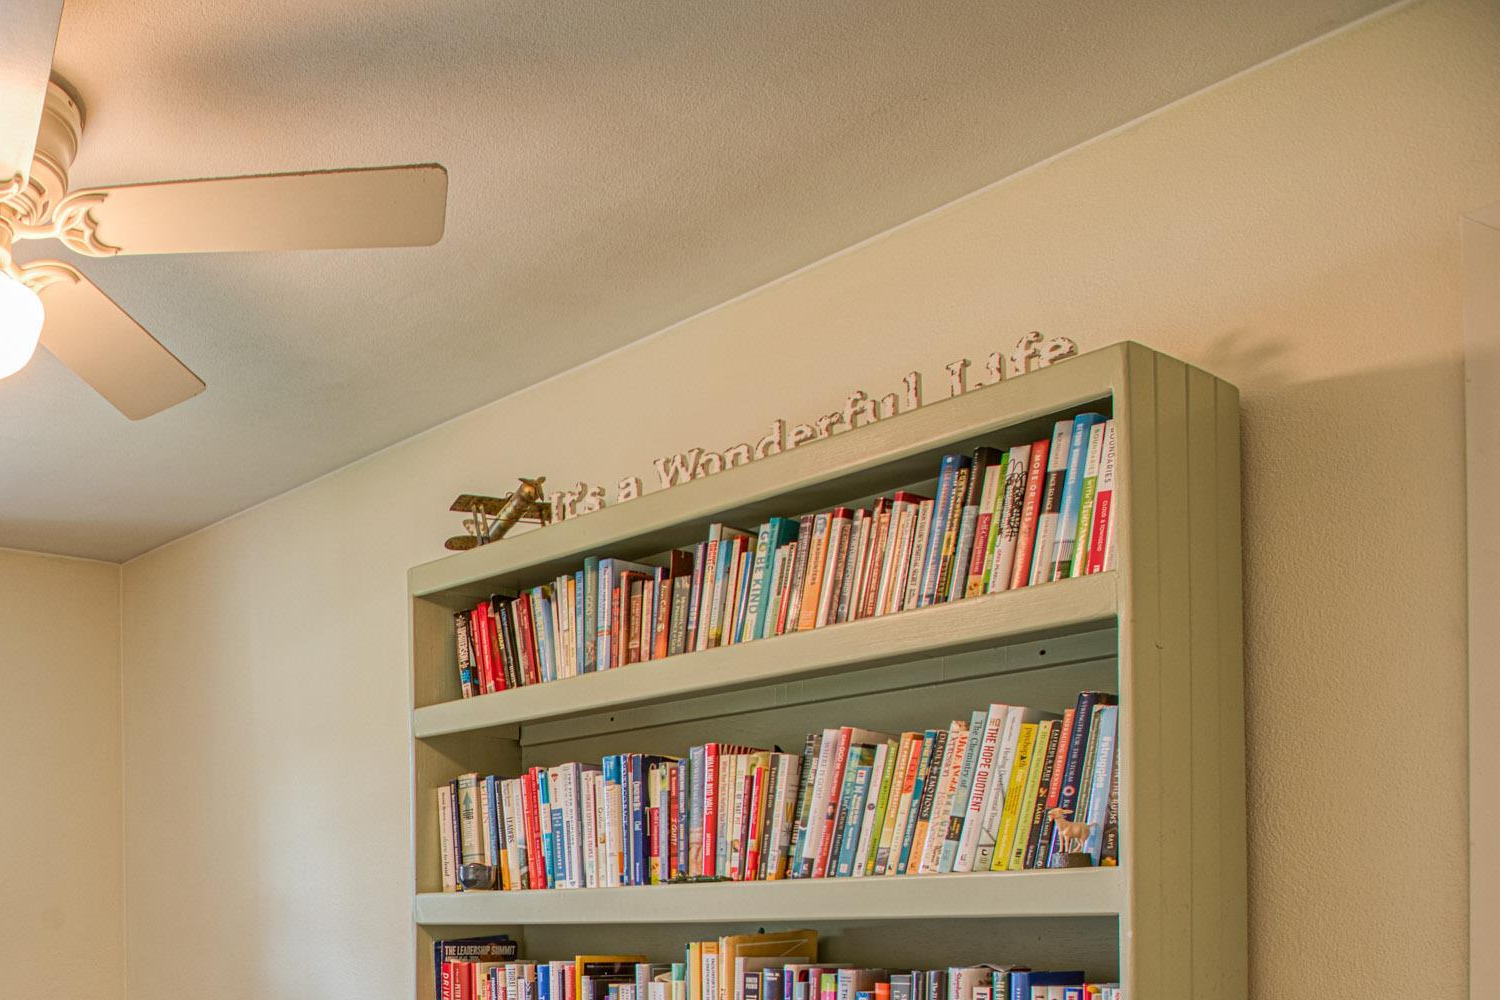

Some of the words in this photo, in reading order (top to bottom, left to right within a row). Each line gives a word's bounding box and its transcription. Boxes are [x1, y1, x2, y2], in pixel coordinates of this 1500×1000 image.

[550, 481, 606, 524] It's
[616, 477, 643, 504] a
[653, 371, 922, 490] Wonderful
[1087, 428, 1100, 475] BOUNDARIES
[1031, 454, 1041, 483] MORE
[1029, 485, 1037, 497] OR
[1024, 501, 1034, 522] LESS
[759, 531, 769, 552] GO
[974, 516, 991, 573] Self-Compassion
[754, 557, 766, 577] BE
[810, 538, 822, 585] HEADHUNTERS
[748, 579, 764, 614] KIND
[972, 721, 983, 735] The
[1075, 701, 1087, 732] STRENGTH
[983, 728, 999, 744] THE
[1059, 714, 1071, 752] EMBRACING
[820, 742, 830, 768] WHERE
[838, 747, 846, 762] GOD
[934, 734, 946, 766] DEADLY
[962, 738, 978, 778] Chemistry
[980, 745, 994, 768] HOPE
[1000, 747, 1011, 768] Healing
[1096, 736, 1110, 788] #struggles
[706, 755, 714, 781] WALKING
[1050, 756, 1064, 798] BROKENNESS
[706, 783, 714, 796] INTO
[922, 776, 937, 818] EMOTIONS
[960, 780, 967, 788] of
[970, 771, 989, 812] QUOTIENT
[991, 770, 1005, 810] Developmental
[705, 797, 714, 816] WALLS
[1109, 799, 1117, 824] RUINS
[506, 816, 514, 844] LEADERS
[445, 946, 456, 956] THE
[457, 946, 491, 956] LEADERSHIP
[492, 946, 515, 956] SUMMIT
